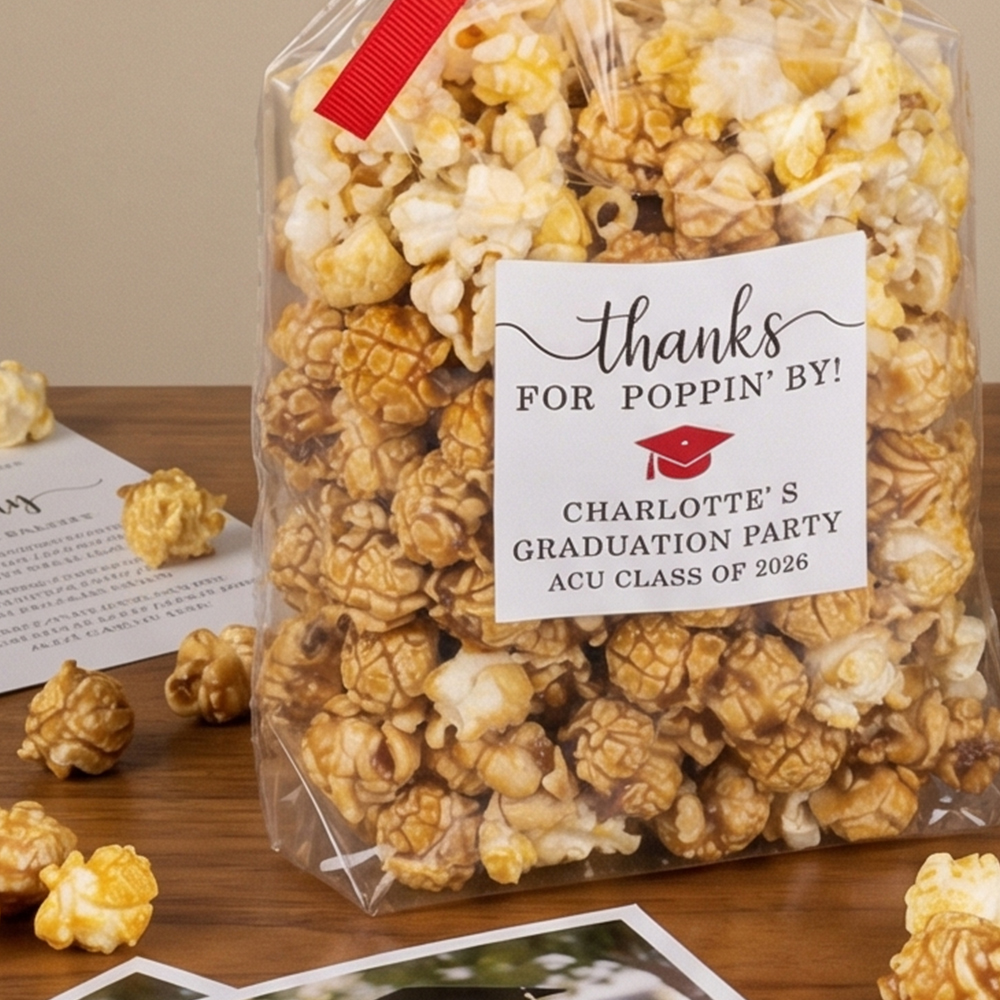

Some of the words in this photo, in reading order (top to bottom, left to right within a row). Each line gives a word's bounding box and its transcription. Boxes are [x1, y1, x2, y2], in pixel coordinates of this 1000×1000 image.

[495, 283, 864, 373] thanks
[516, 385, 595, 411] FOR
[621, 370, 773, 409] POPPIN'
[785, 357, 841, 390] BY!
[513, 529, 730, 561] GRADUATION
[743, 511, 842, 547] PARTY
[549, 572, 604, 592] ACU
[615, 568, 702, 588] CLASS
[712, 563, 746, 583] OF
[755, 553, 809, 577] 2026
